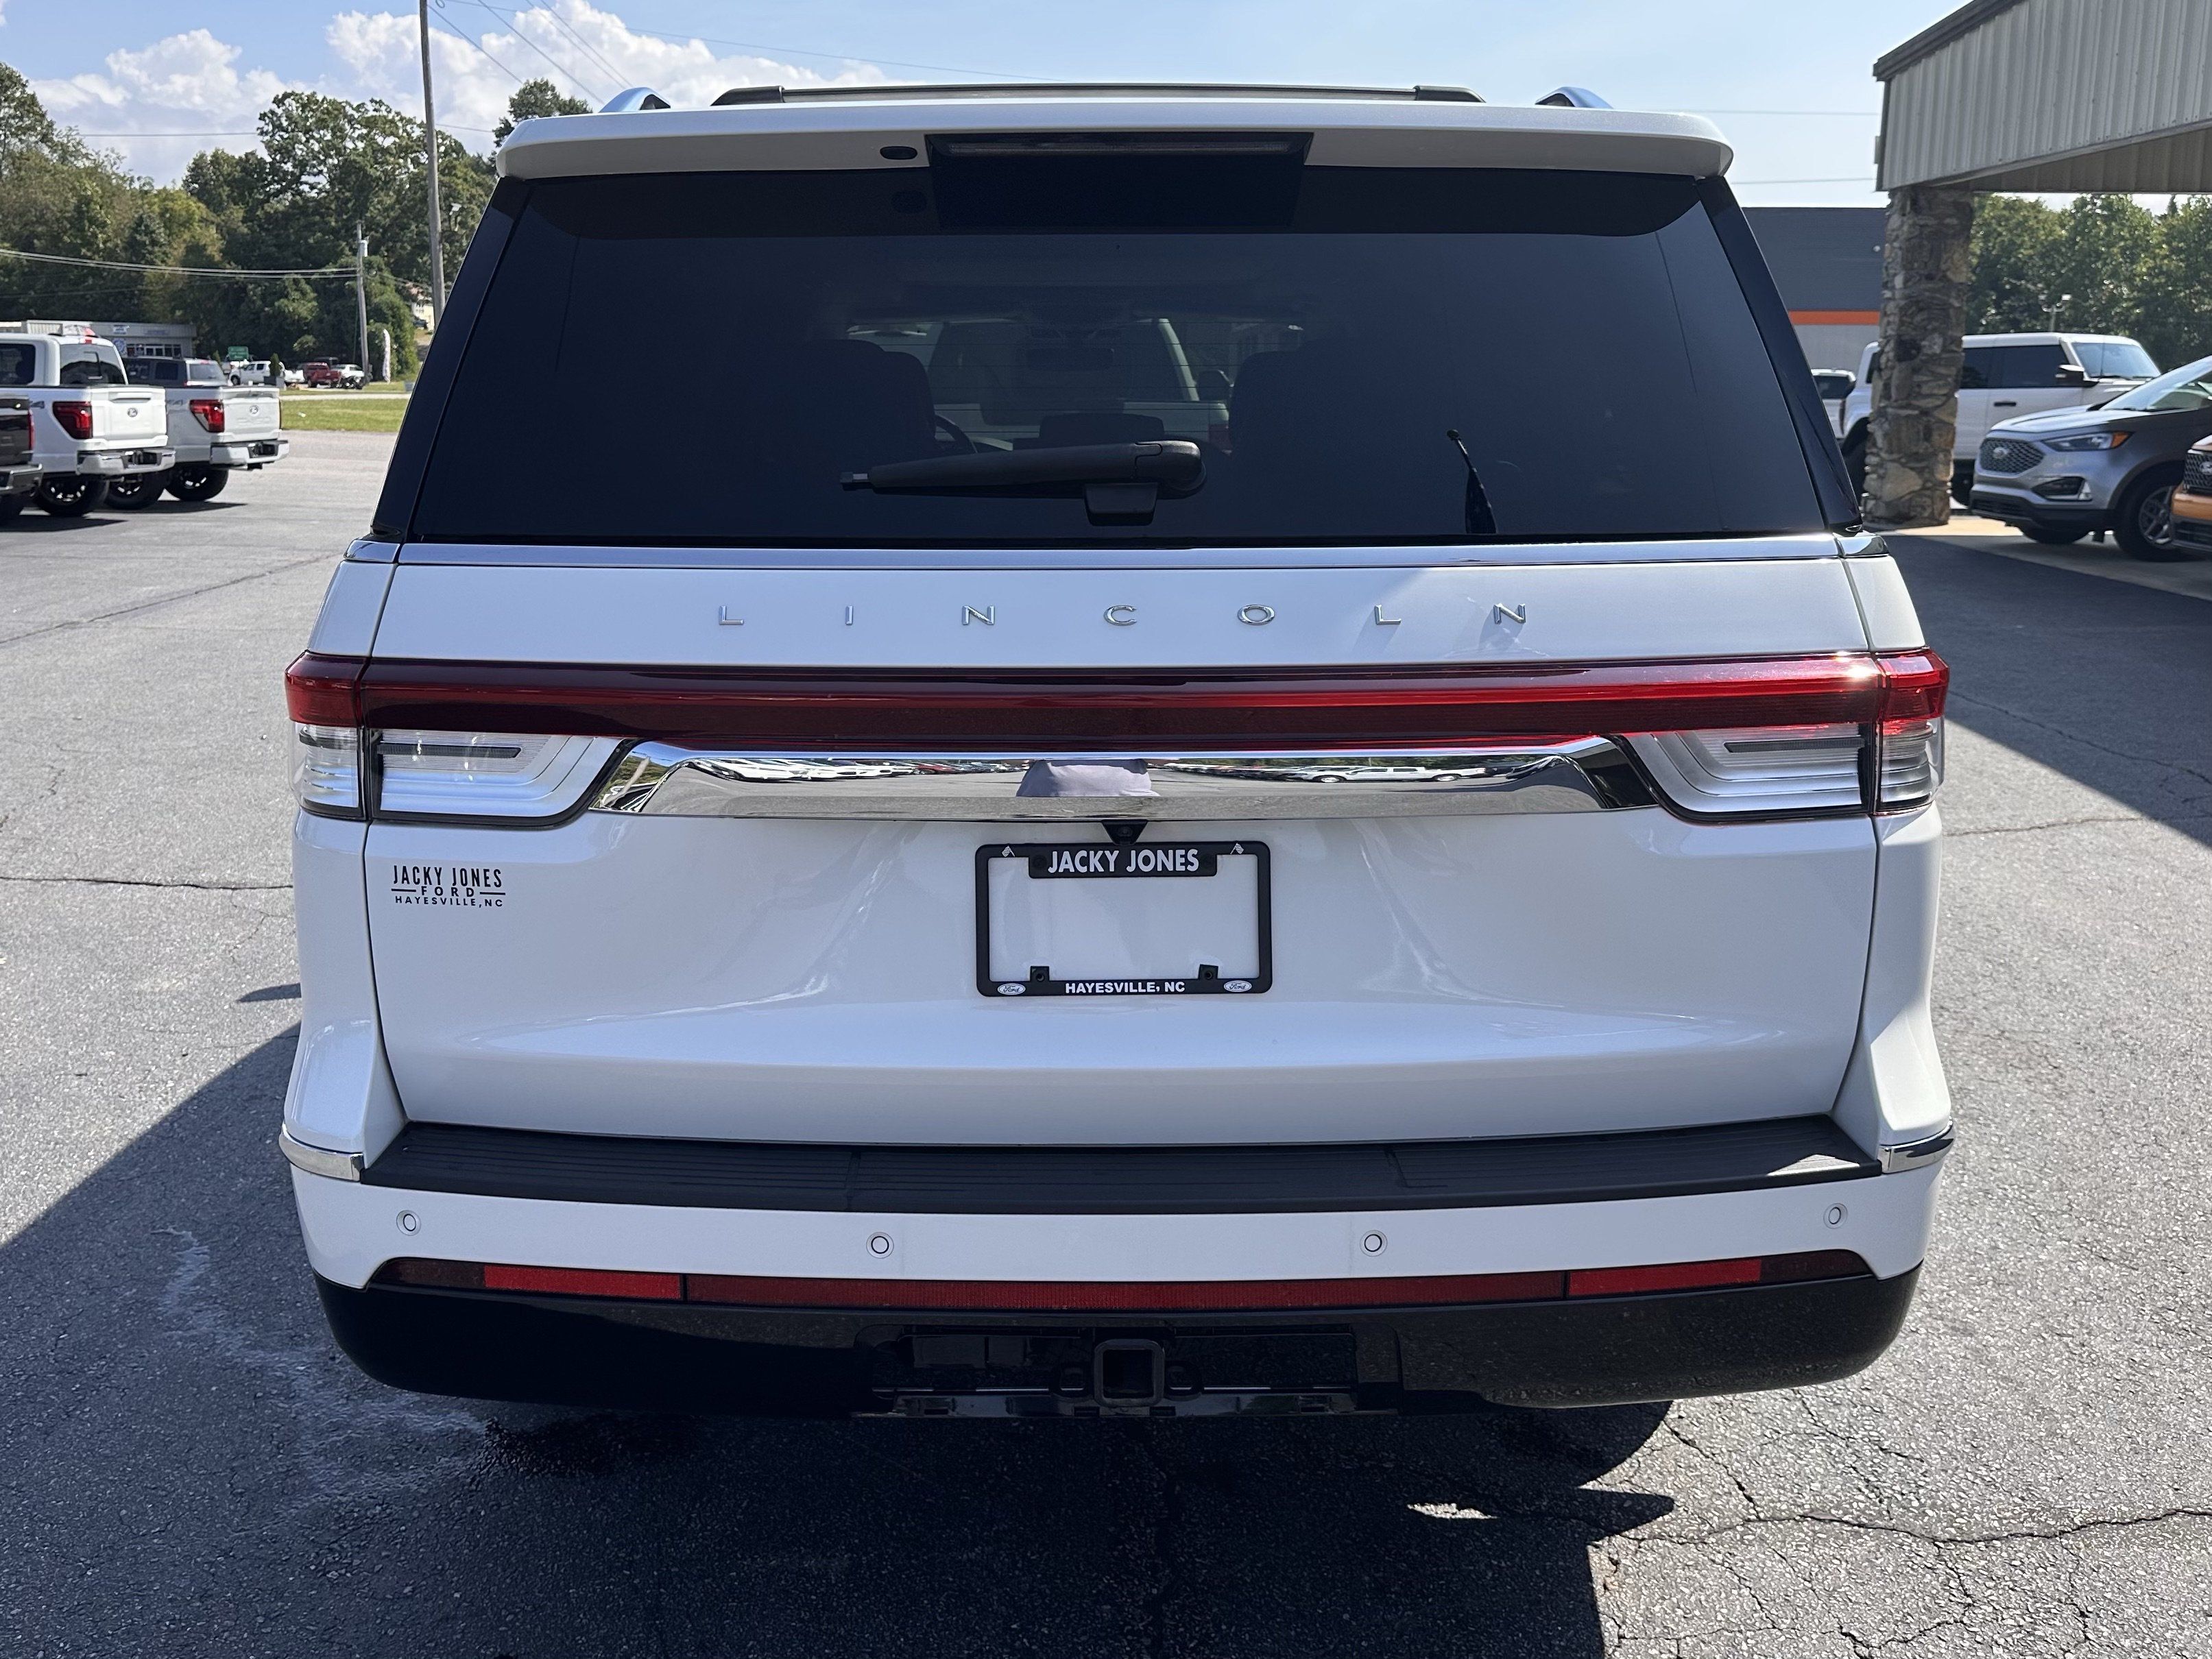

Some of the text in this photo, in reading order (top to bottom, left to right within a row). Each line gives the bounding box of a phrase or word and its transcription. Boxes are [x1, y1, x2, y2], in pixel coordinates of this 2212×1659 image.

[719, 604, 1526, 626] LINCOLN
[1048, 849, 1199, 873] JACKY JONES
[394, 865, 502, 887] JACKY JONES
[421, 886, 474, 897] FORD
[1065, 981, 1185, 994] HAYESVILLE, NC
